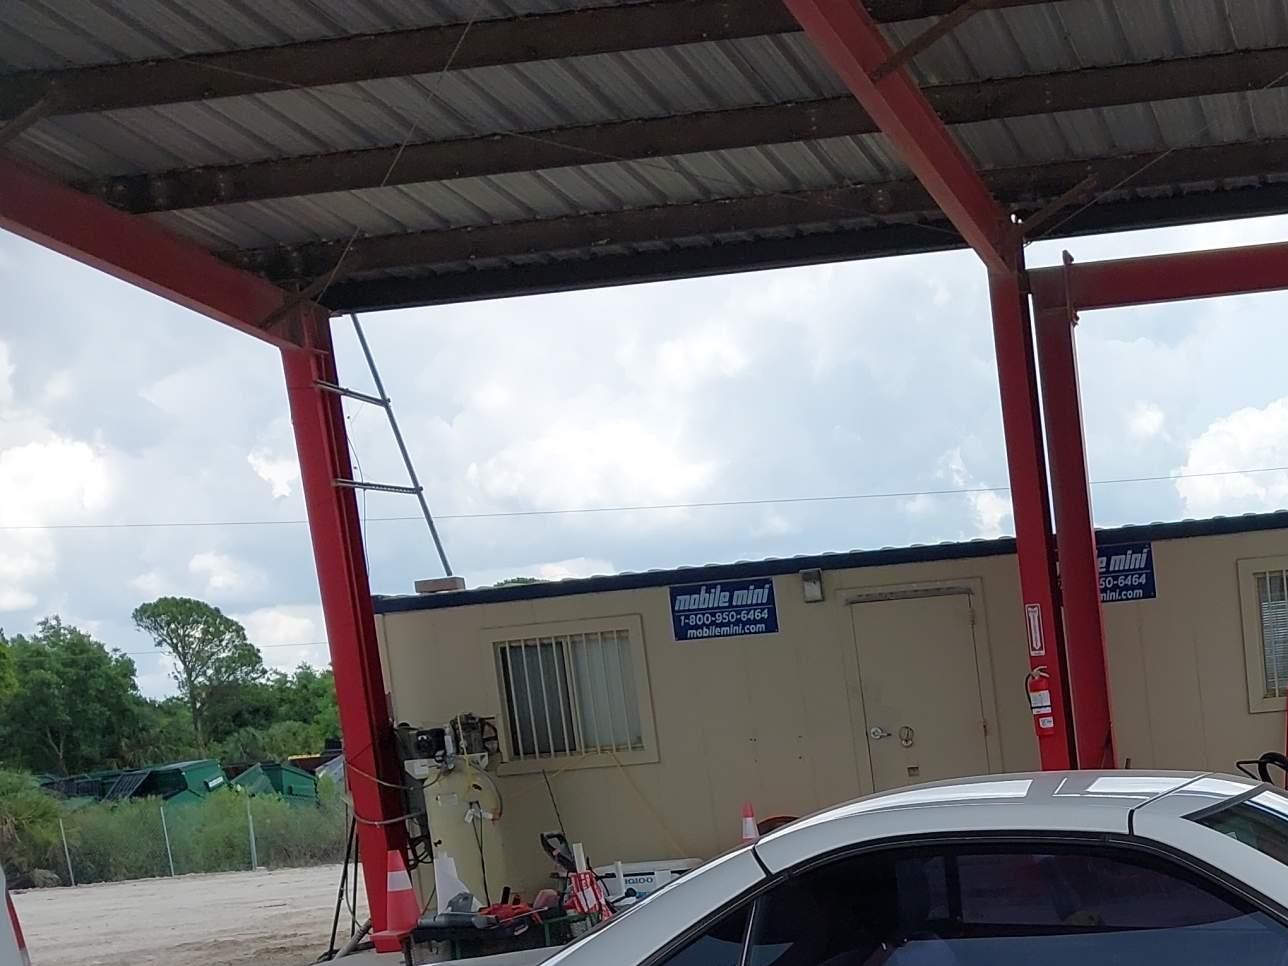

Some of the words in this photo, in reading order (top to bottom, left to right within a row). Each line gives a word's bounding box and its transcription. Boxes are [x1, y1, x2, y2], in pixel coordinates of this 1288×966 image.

[1109, 548, 1149, 571] mini
[1099, 573, 1147, 588] 50-6464
[674, 585, 730, 611] mobile
[732, 583, 770, 606] mini
[1100, 589, 1143, 601] mini.com
[680, 608, 769, 627] 1-800-950-6464
[687, 623, 766, 638] mobilemini.com
